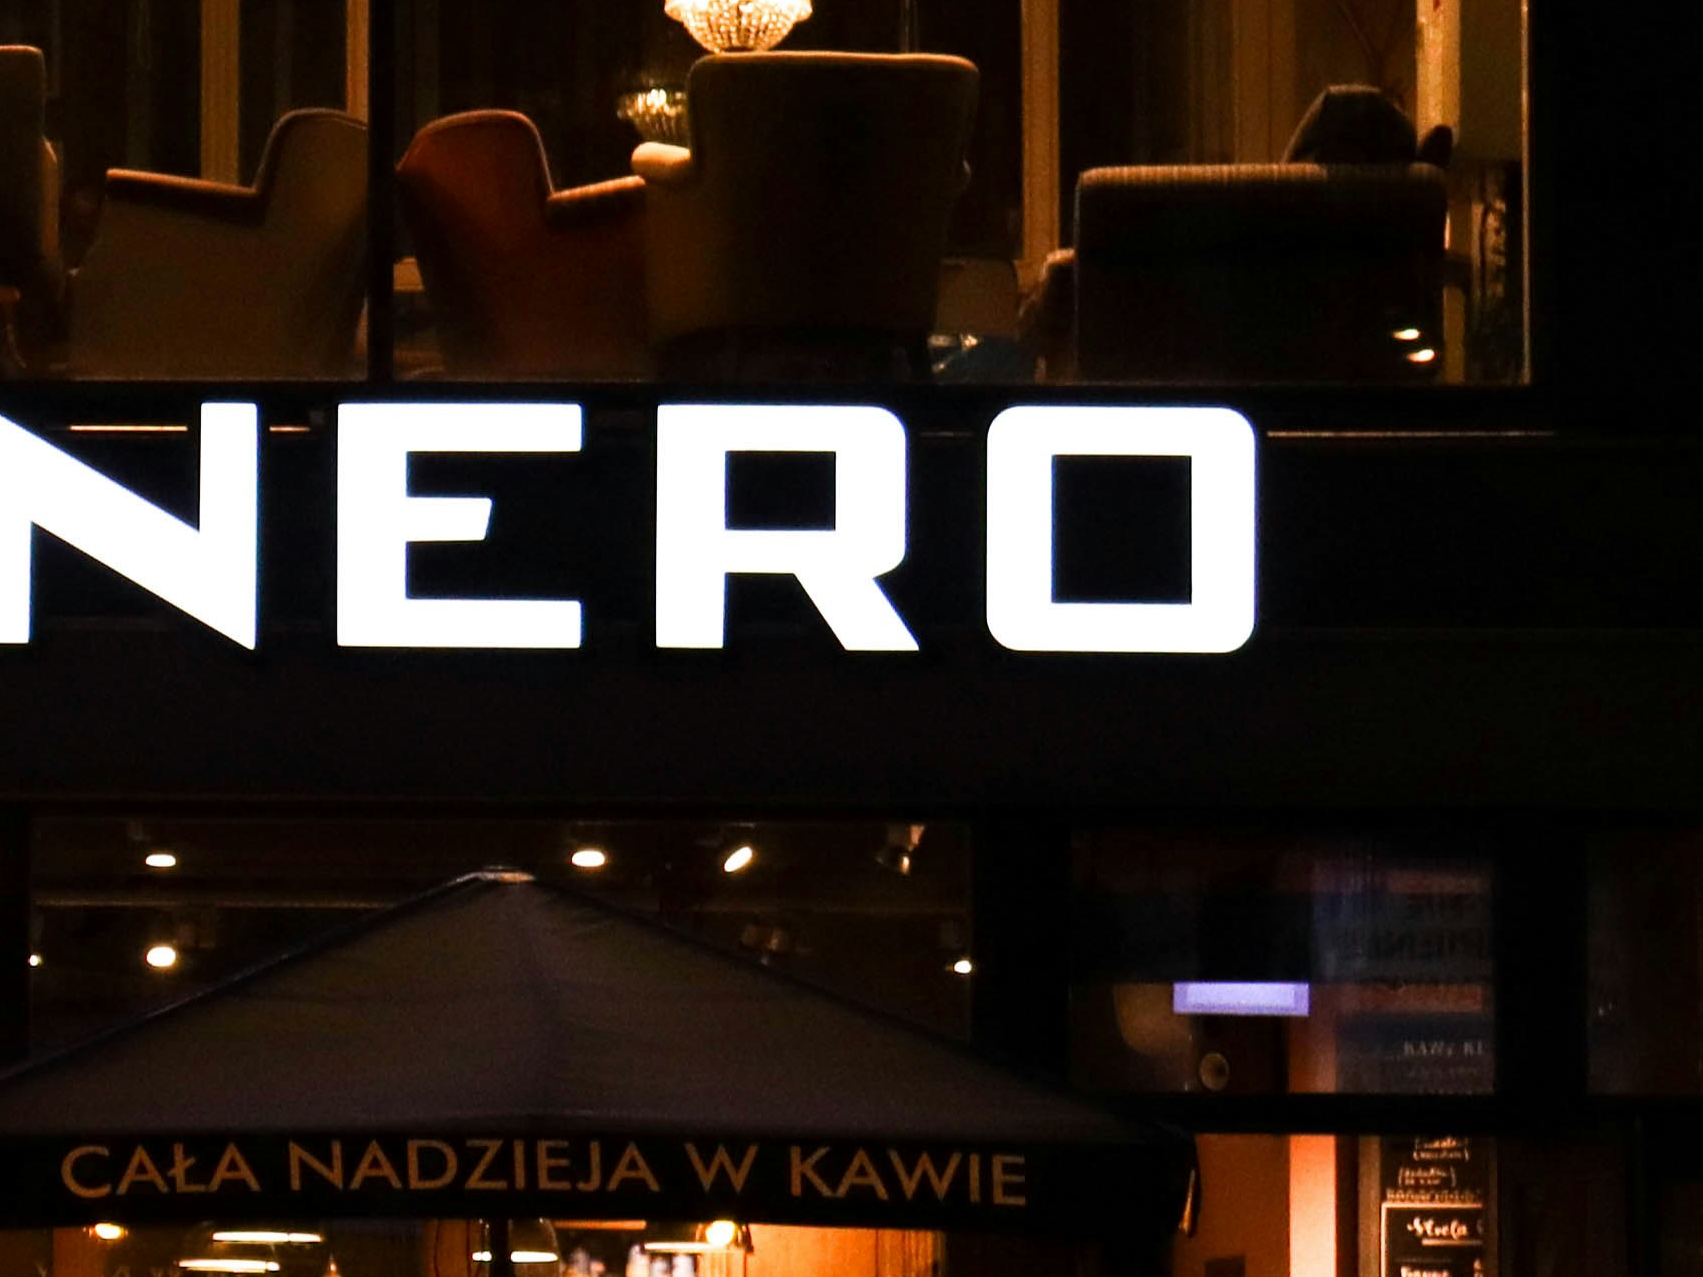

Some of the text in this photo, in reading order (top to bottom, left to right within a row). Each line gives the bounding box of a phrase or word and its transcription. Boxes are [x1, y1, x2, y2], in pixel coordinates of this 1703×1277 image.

[59, 1139, 1028, 1206] CAŁA NADZIEJA W KAWIE
